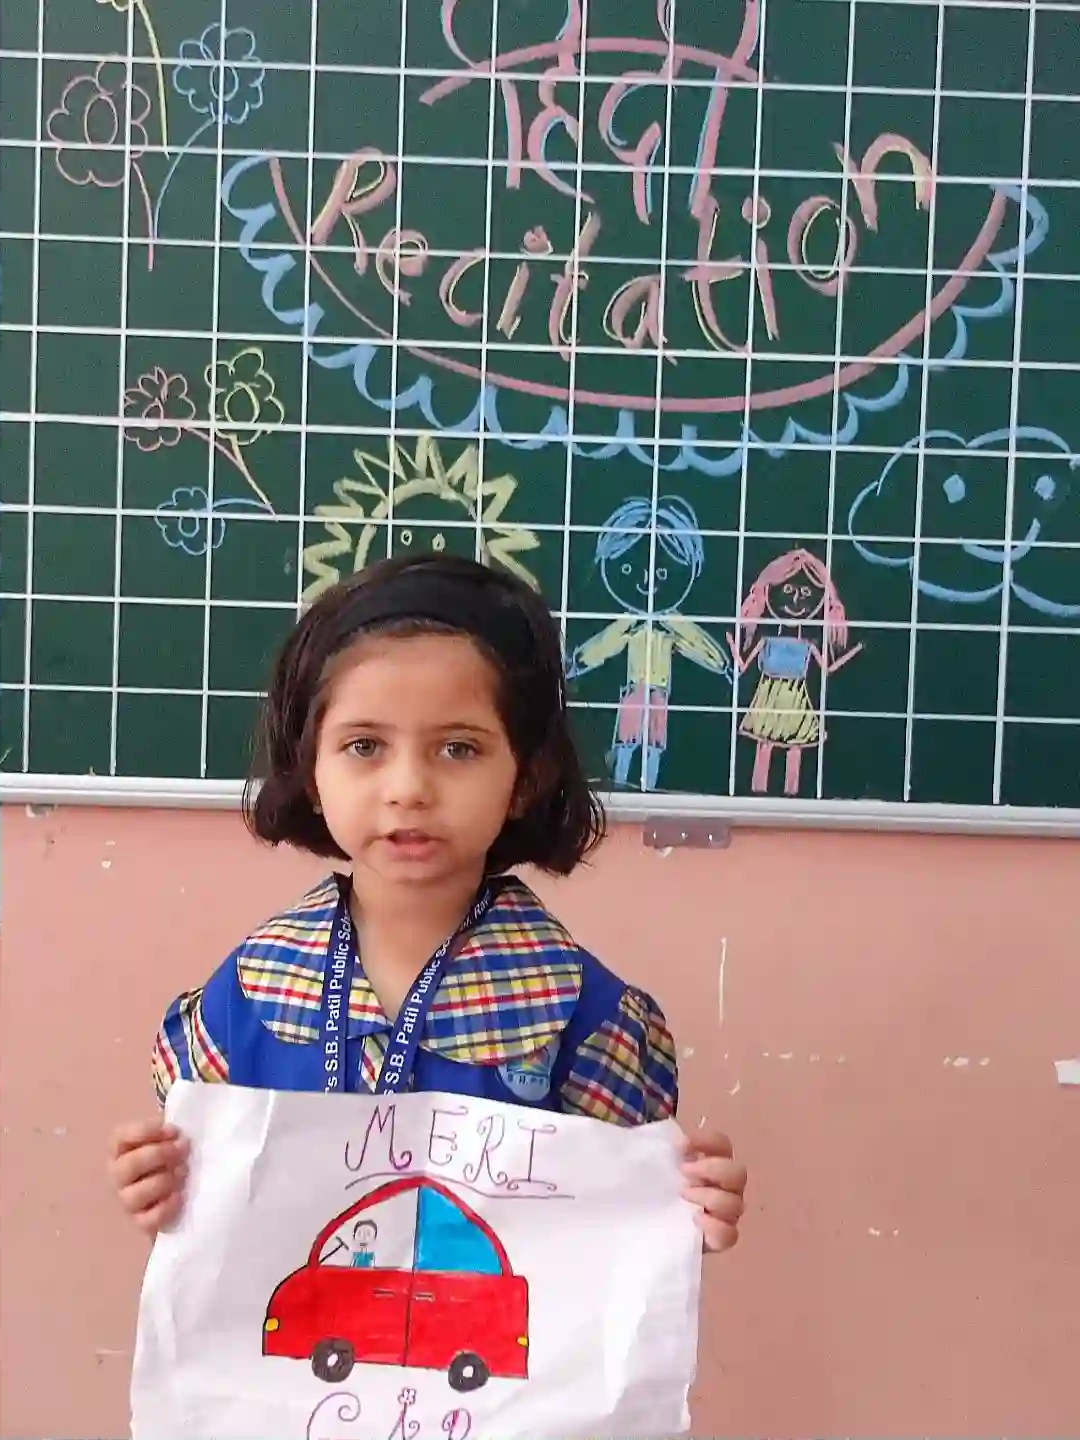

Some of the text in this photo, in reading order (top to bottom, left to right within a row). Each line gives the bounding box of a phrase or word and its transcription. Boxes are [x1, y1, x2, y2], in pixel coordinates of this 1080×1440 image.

[311, 131, 933, 363] Recitation
[330, 943, 349, 990] Public
[326, 994, 342, 1031] Patil
[385, 1050, 406, 1084] S.B.
[396, 1007, 419, 1044] Patil
[411, 960, 440, 1004] Public
[325, 1036, 338, 1072] S.B.
[345, 1103, 557, 1191] MERI
